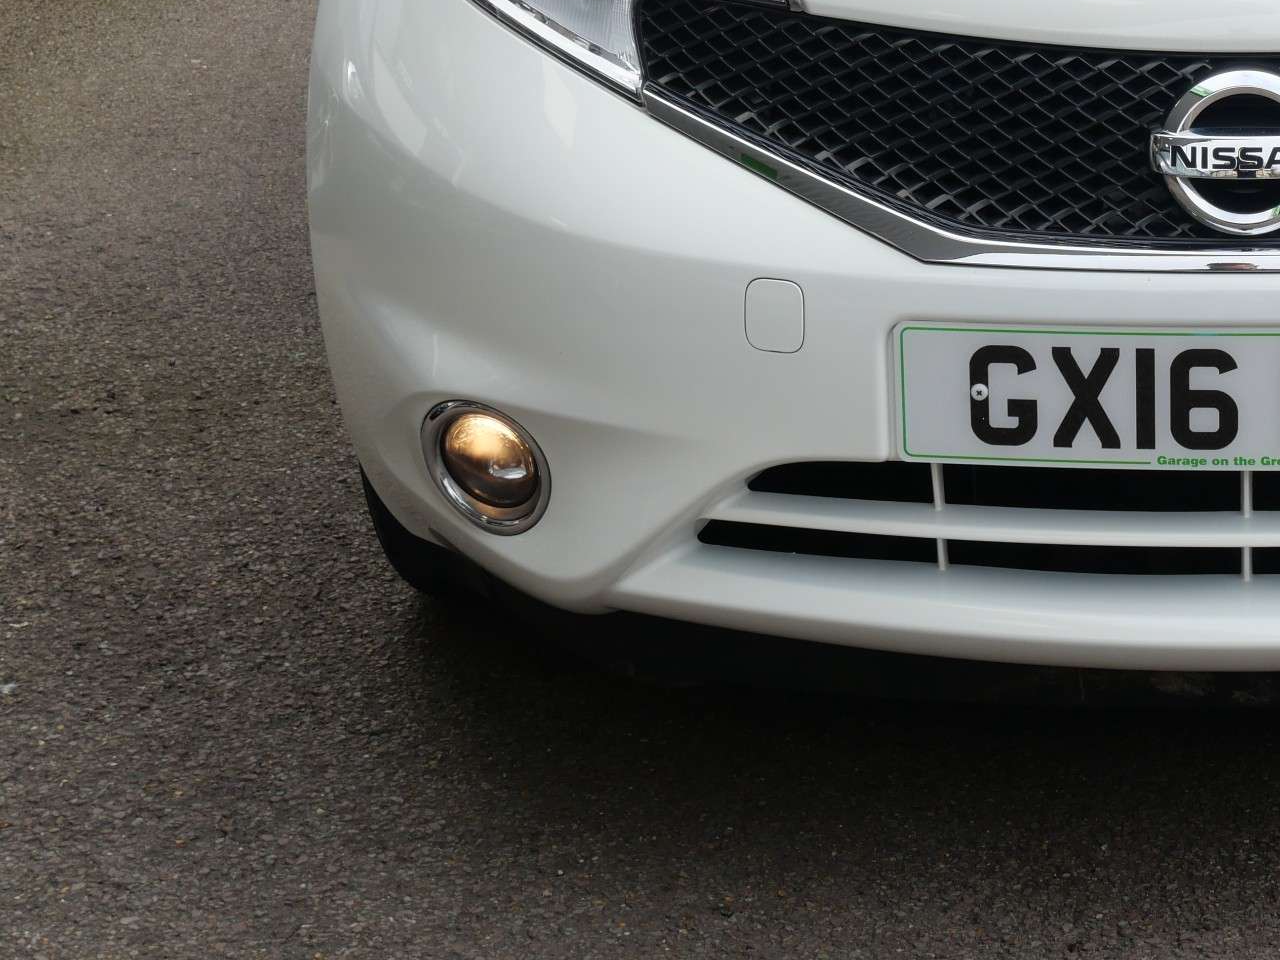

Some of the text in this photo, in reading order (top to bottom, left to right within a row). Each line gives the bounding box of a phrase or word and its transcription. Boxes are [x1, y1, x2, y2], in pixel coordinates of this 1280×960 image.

[968, 343, 1240, 451] GX16
[1156, 455, 1207, 467] Garage
[1211, 458, 1230, 466] on
[1233, 456, 1256, 466] the
